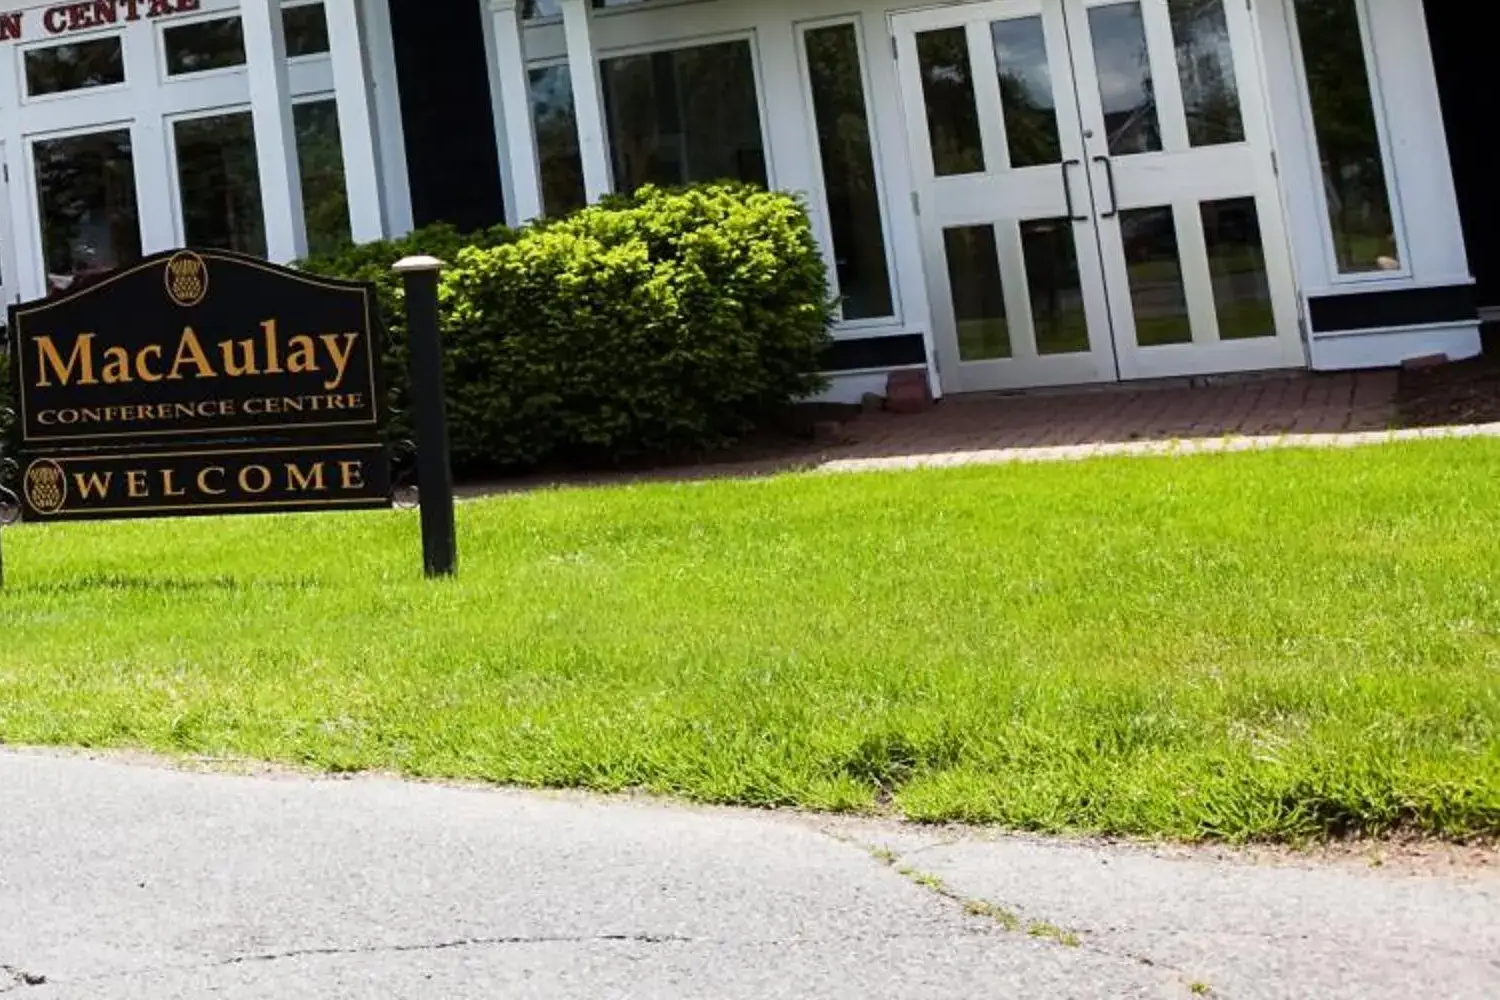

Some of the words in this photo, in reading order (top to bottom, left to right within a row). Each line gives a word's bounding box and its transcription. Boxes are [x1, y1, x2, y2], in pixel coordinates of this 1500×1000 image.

[31, 318, 360, 390] MacAulay
[36, 399, 236, 426] CONFERENCE
[242, 392, 364, 416] CENTRE
[73, 460, 365, 500] WELCOME
